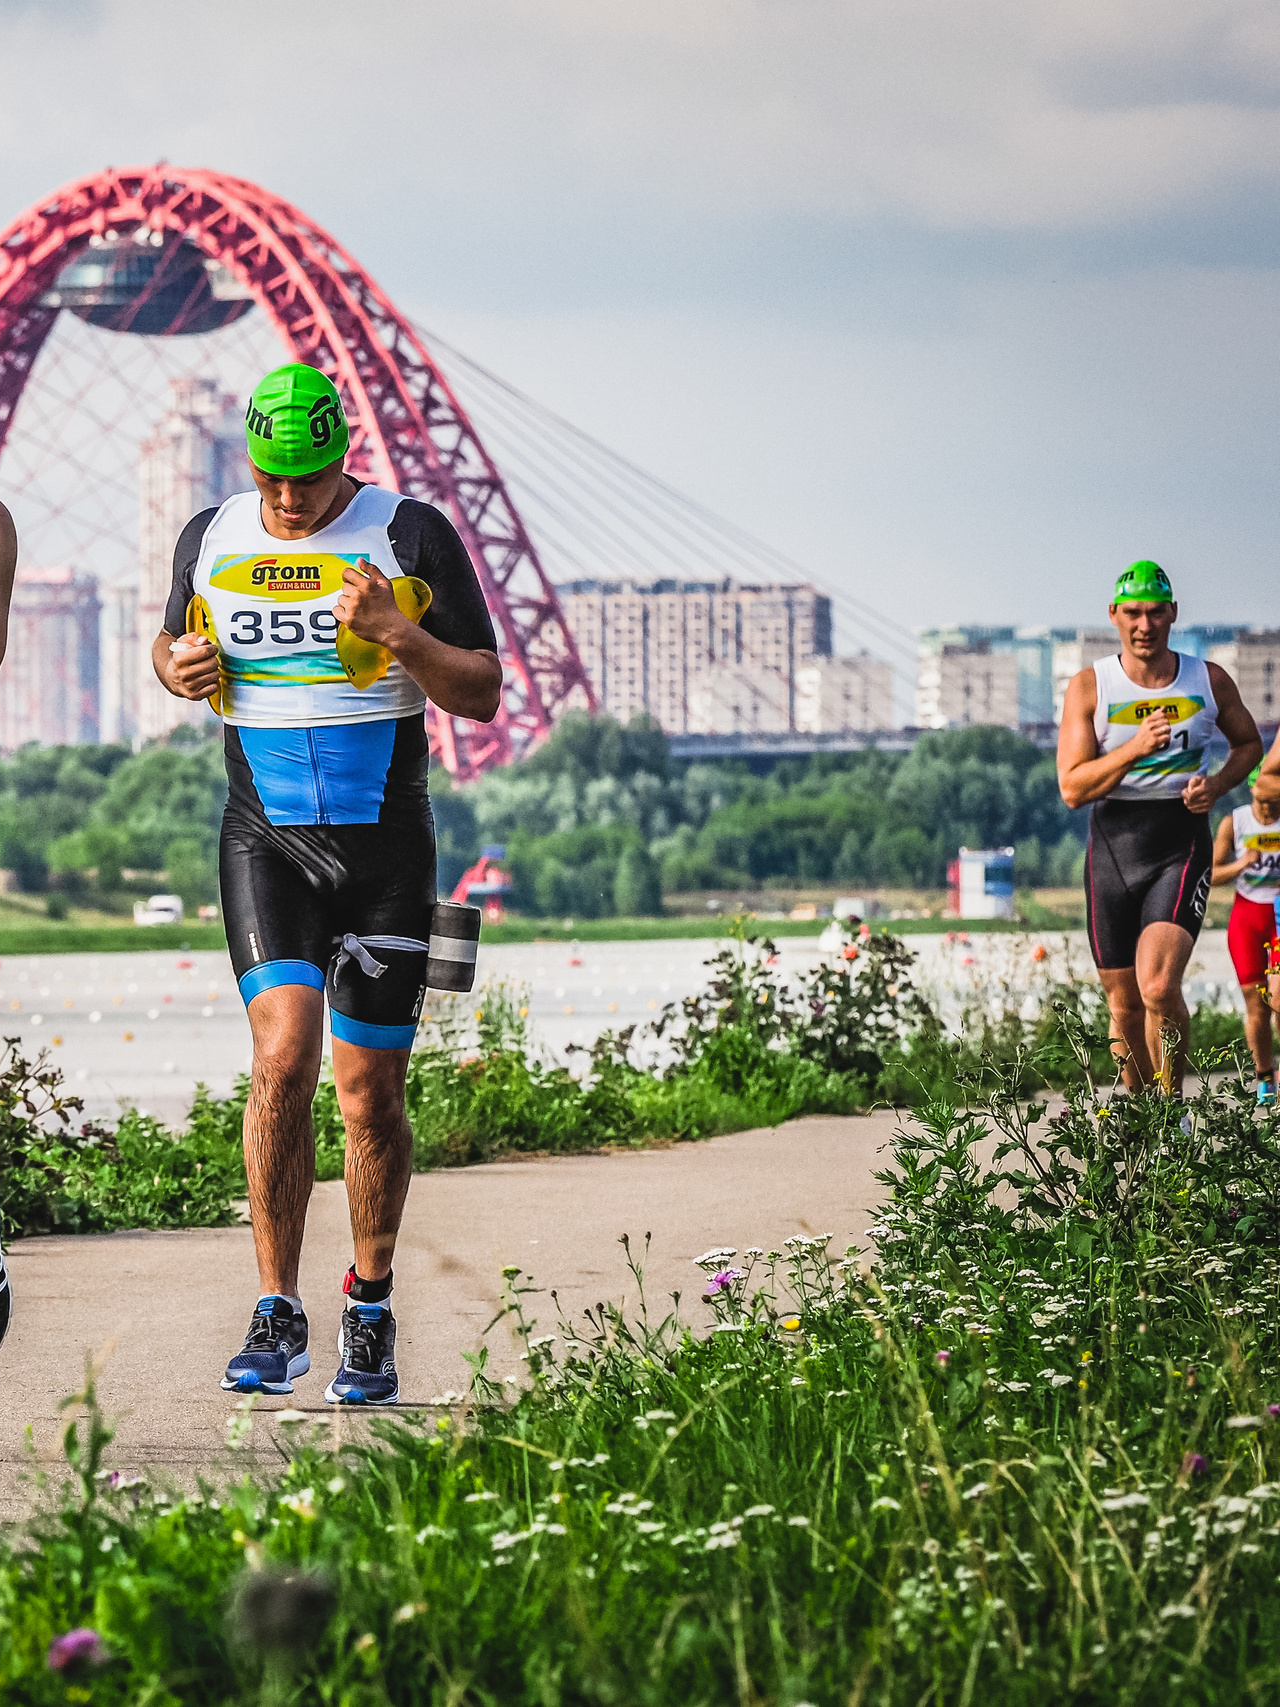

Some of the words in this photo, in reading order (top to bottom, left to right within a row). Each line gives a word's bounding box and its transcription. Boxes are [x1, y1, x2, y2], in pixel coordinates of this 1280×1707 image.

[251, 566, 320, 585] grom
[271, 582, 317, 590] SWIM&RUN
[230, 610, 340, 644] 359
